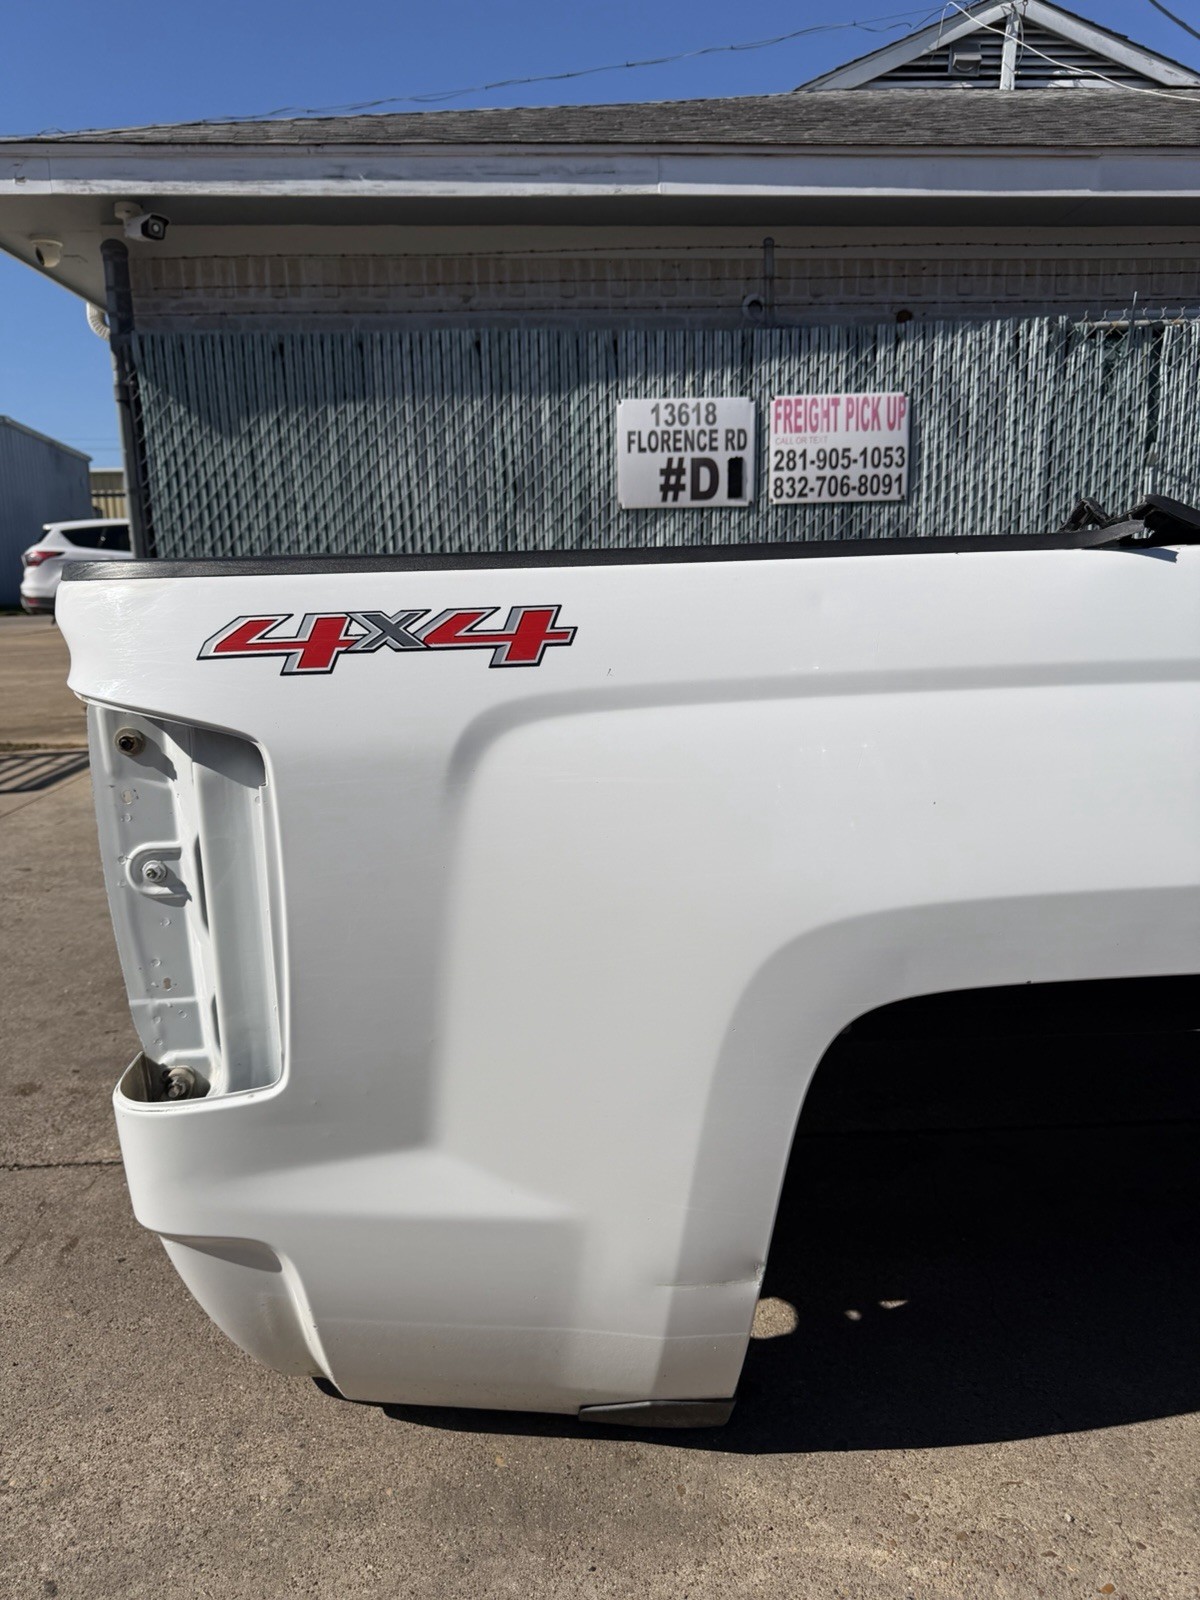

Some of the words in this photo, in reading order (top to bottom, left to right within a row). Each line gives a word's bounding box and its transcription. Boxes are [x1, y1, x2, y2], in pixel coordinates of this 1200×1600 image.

[651, 402, 717, 427] 13618
[774, 397, 840, 434] FREIGHT
[845, 397, 881, 432] PICK
[887, 396, 906, 430] UP
[627, 429, 718, 454] FLORENCE
[725, 428, 747, 451] RD
[775, 437, 795, 445] CALL
[797, 436, 807, 444] OR
[809, 436, 828, 444] TEXT
[774, 446, 905, 471] 281-905-1053
[773, 473, 903, 499] 832-706-8091
